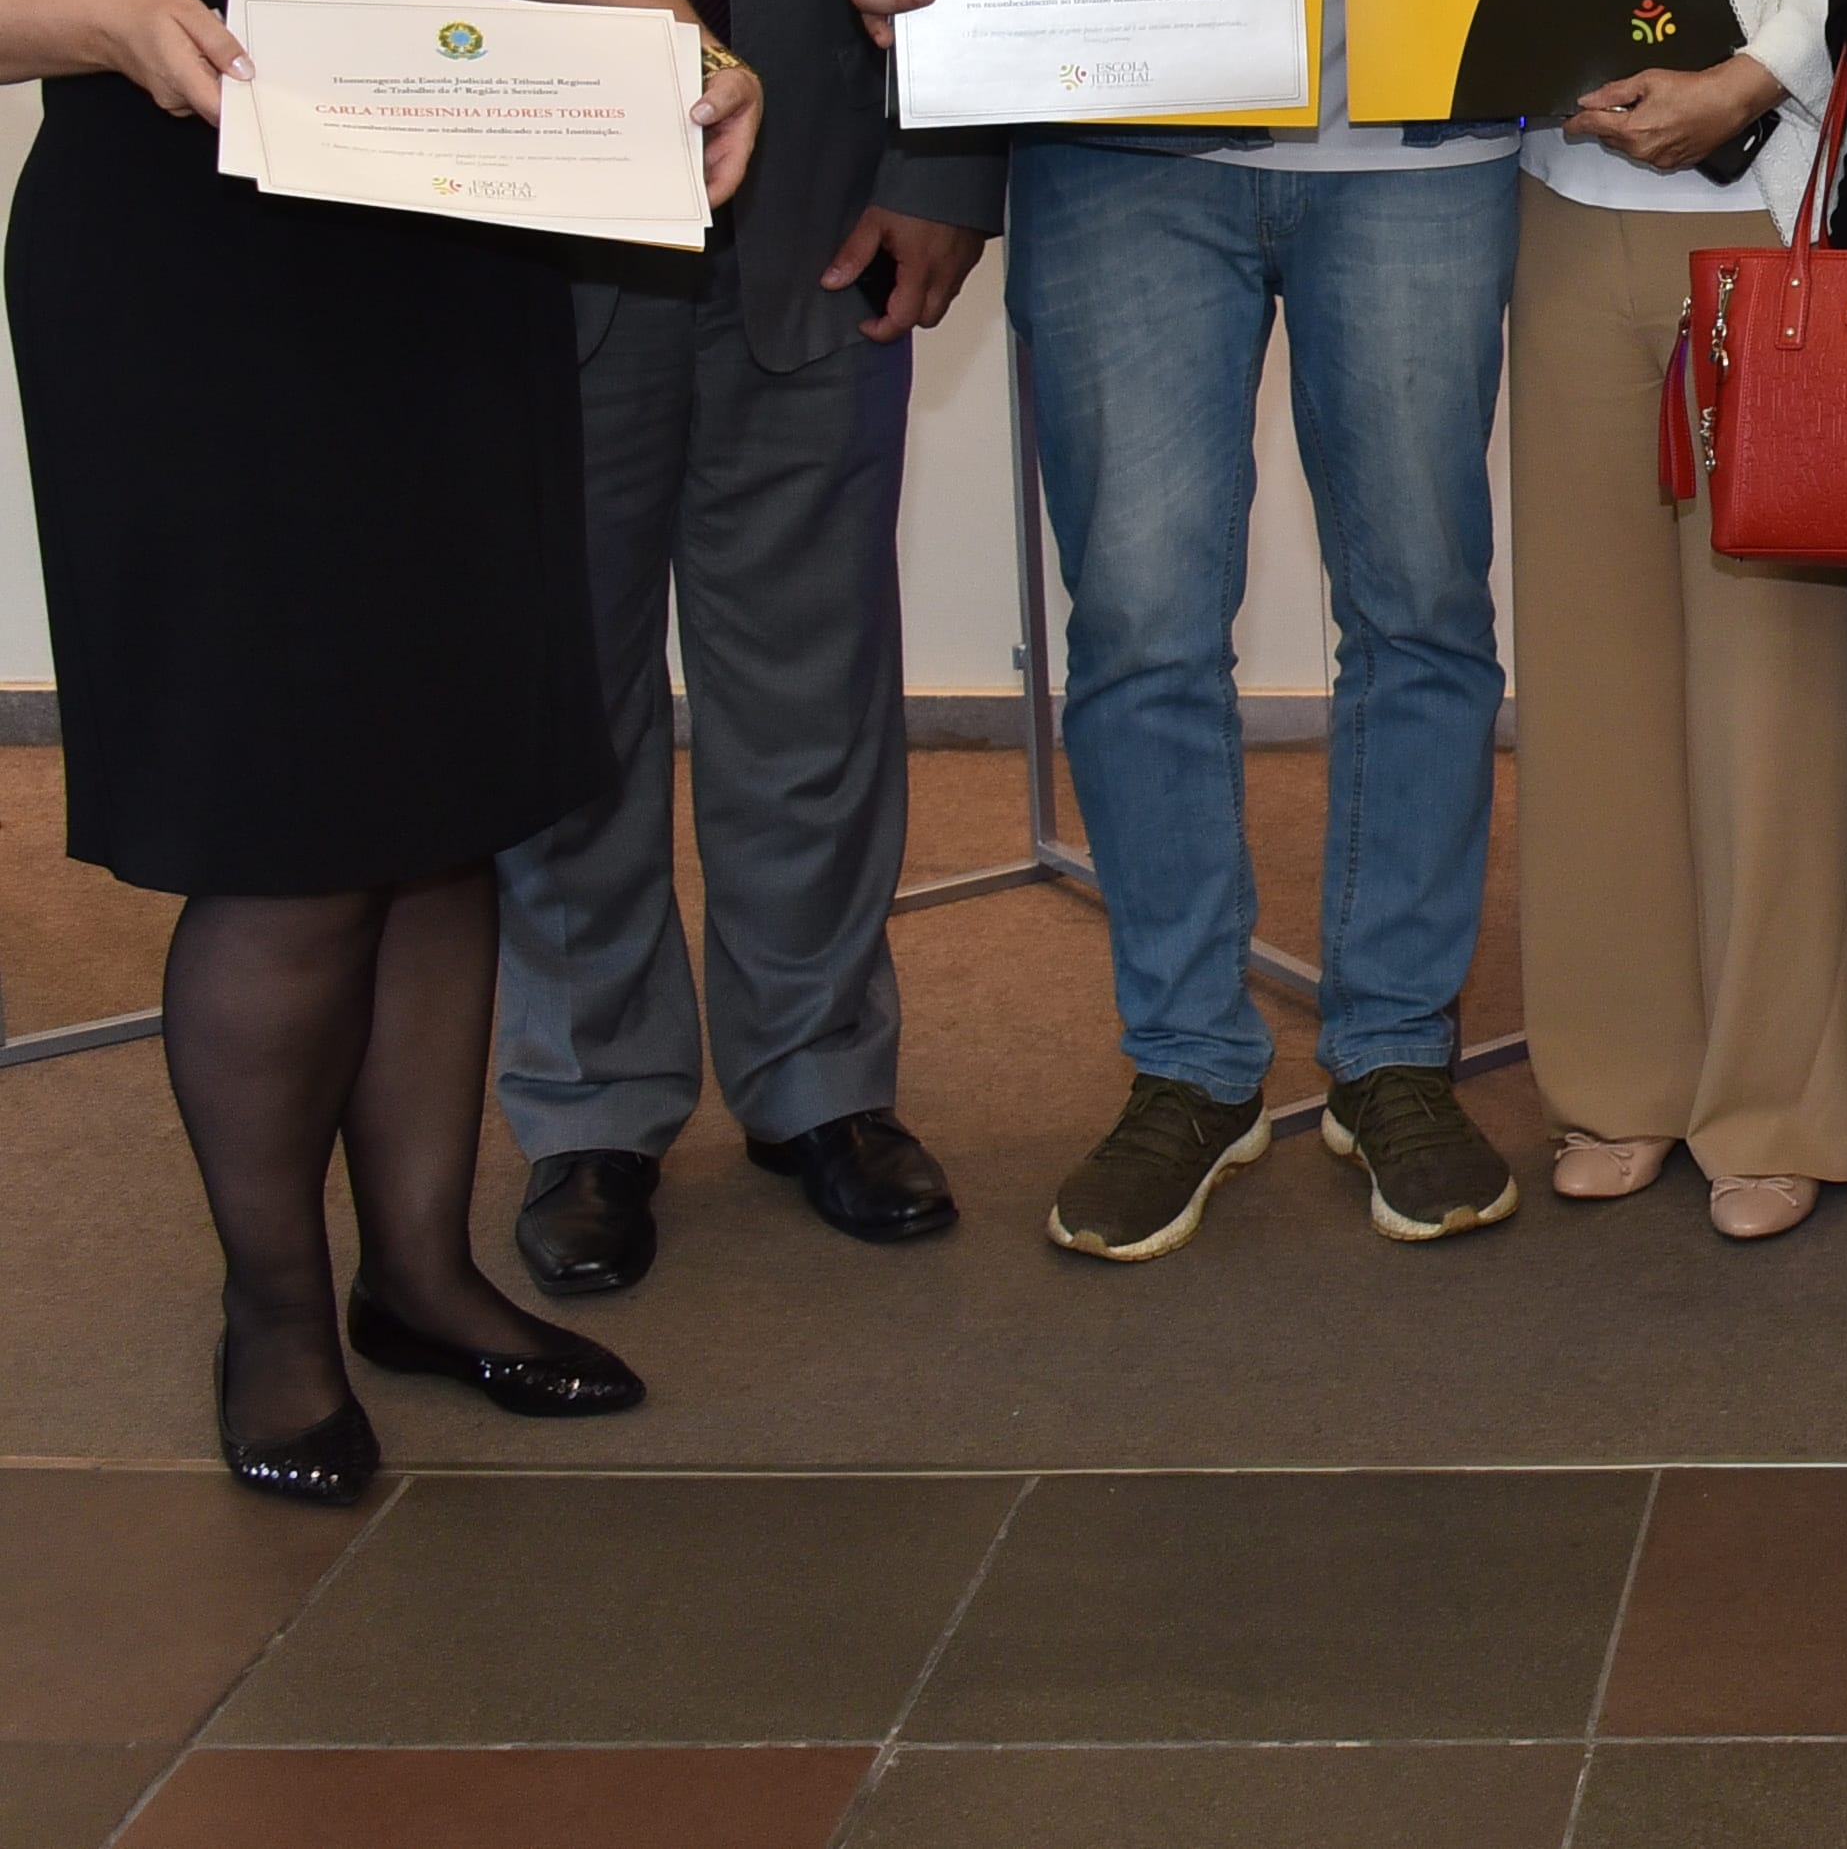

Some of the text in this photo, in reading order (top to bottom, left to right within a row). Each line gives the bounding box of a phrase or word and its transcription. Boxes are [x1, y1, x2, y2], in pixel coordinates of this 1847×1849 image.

[316, 104, 626, 119] CARLA TERESINHA FLORES TORRES
